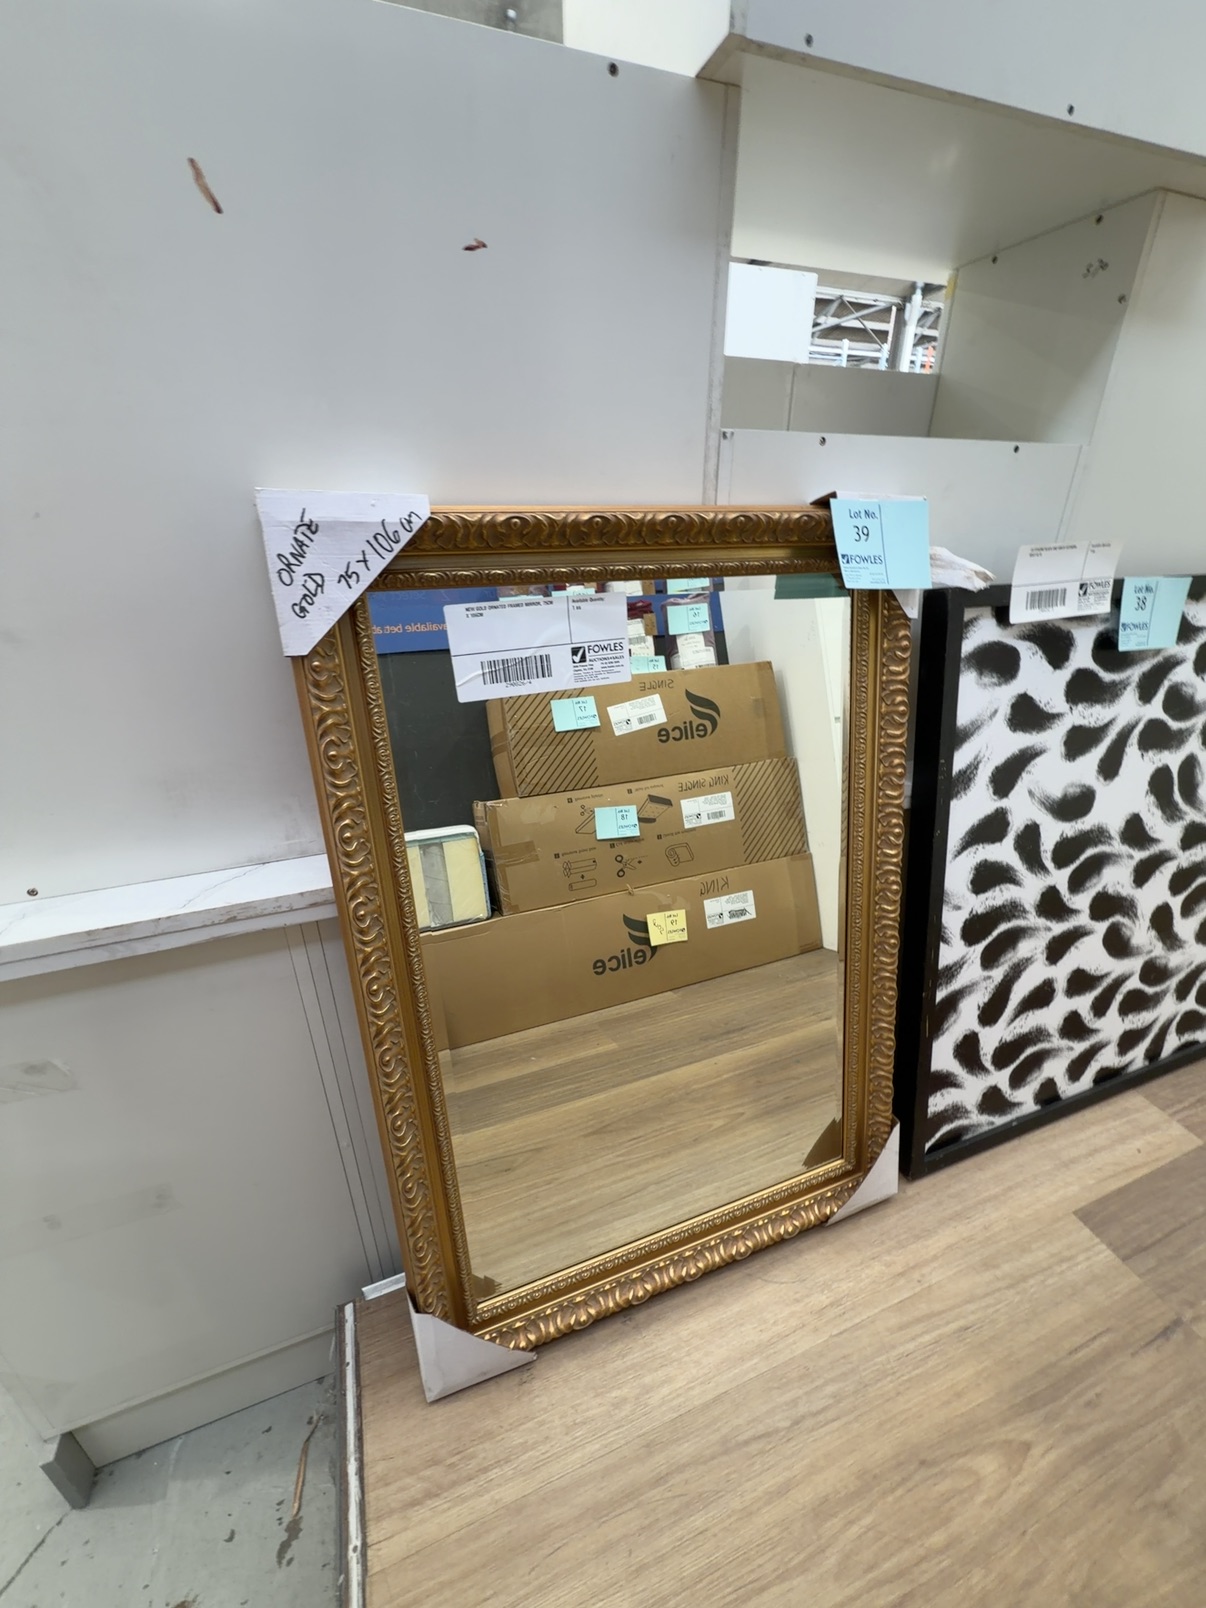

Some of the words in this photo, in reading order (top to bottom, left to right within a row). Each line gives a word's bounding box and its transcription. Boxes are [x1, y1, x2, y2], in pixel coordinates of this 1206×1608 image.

[848, 508, 862, 520] Lot
[864, 508, 879, 520] No.
[853, 525, 870, 542] 39
[276, 508, 319, 587] ORNATE
[337, 561, 360, 589] 75
[366, 519, 401, 560] 106
[850, 554, 883, 565] FOWLES
[292, 572, 325, 619] GOLD
[1134, 595, 1148, 612] 38
[587, 641, 624, 654] FOWLES
